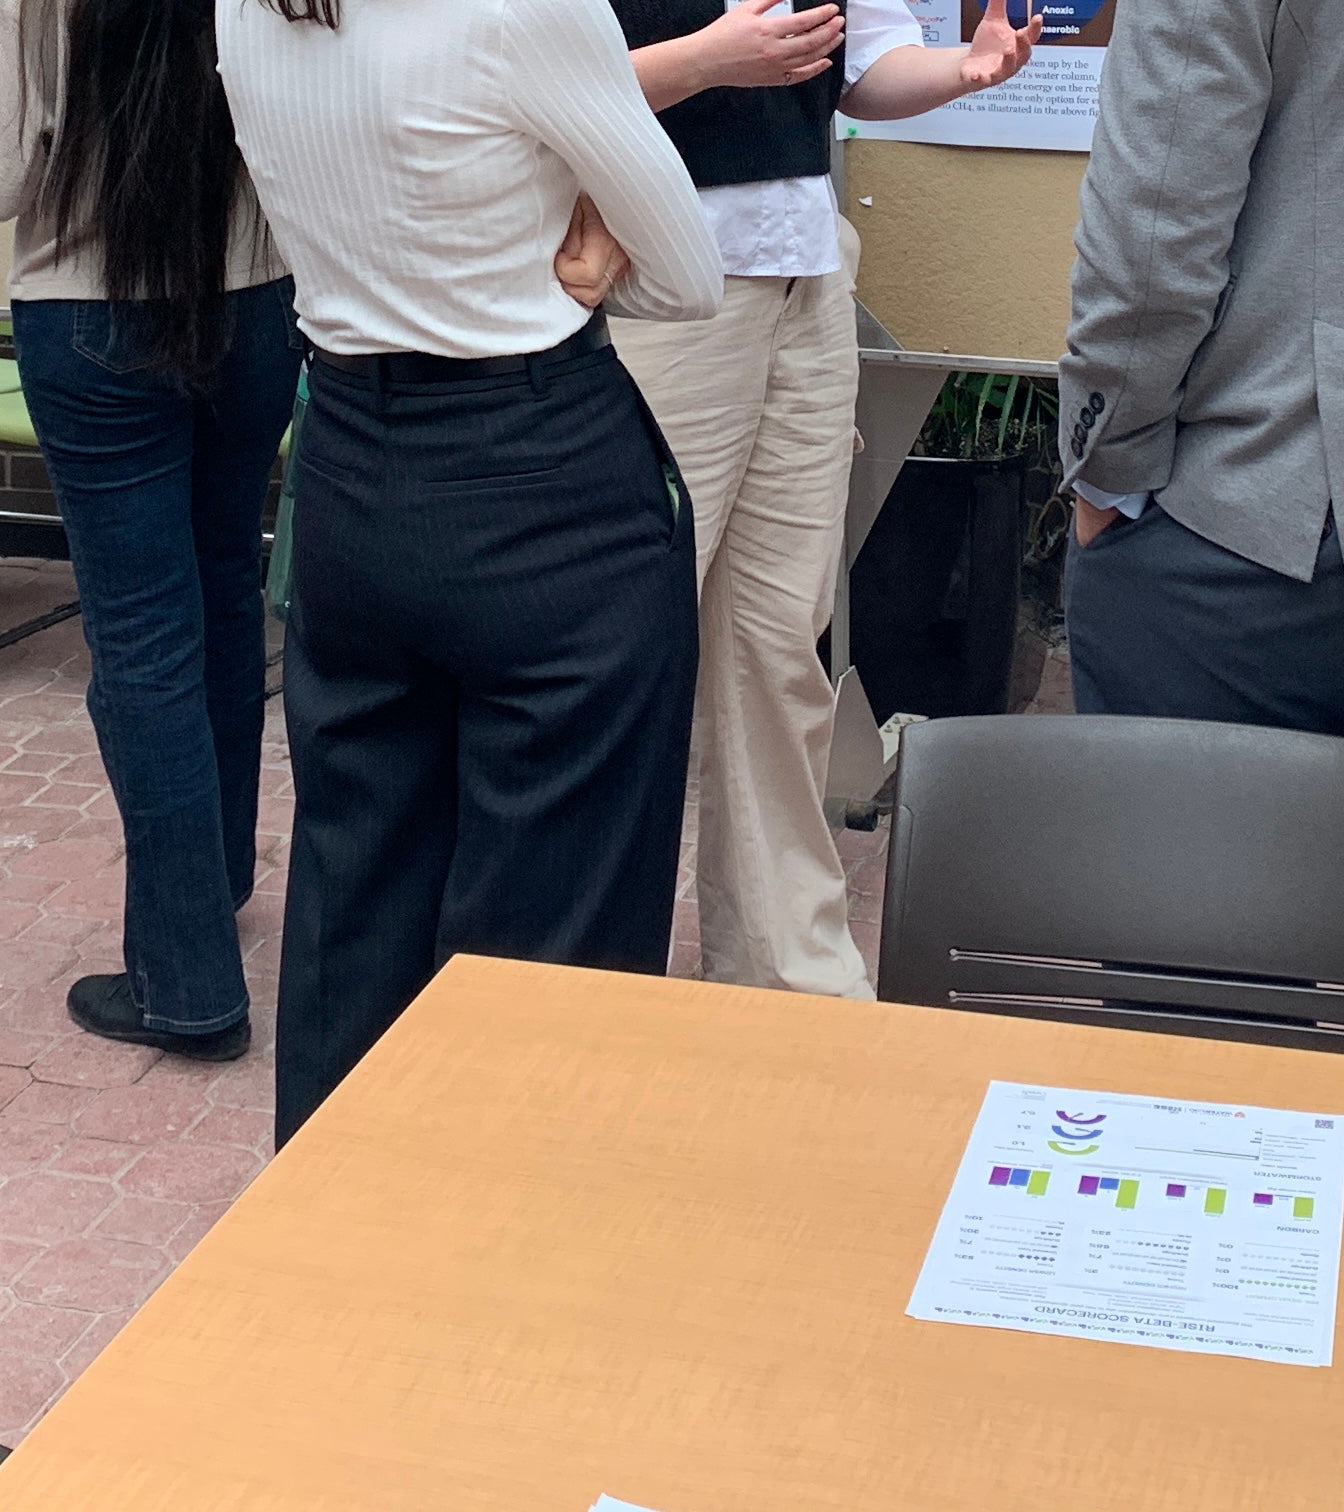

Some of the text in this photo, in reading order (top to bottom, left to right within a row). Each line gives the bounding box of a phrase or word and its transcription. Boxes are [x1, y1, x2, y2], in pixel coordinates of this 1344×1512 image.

[1042, 5, 1074, 15] Anoxic
[1040, 24, 1080, 34] naerobic
[1034, 1305, 1216, 1333] RISE-BETA SCORECARD
